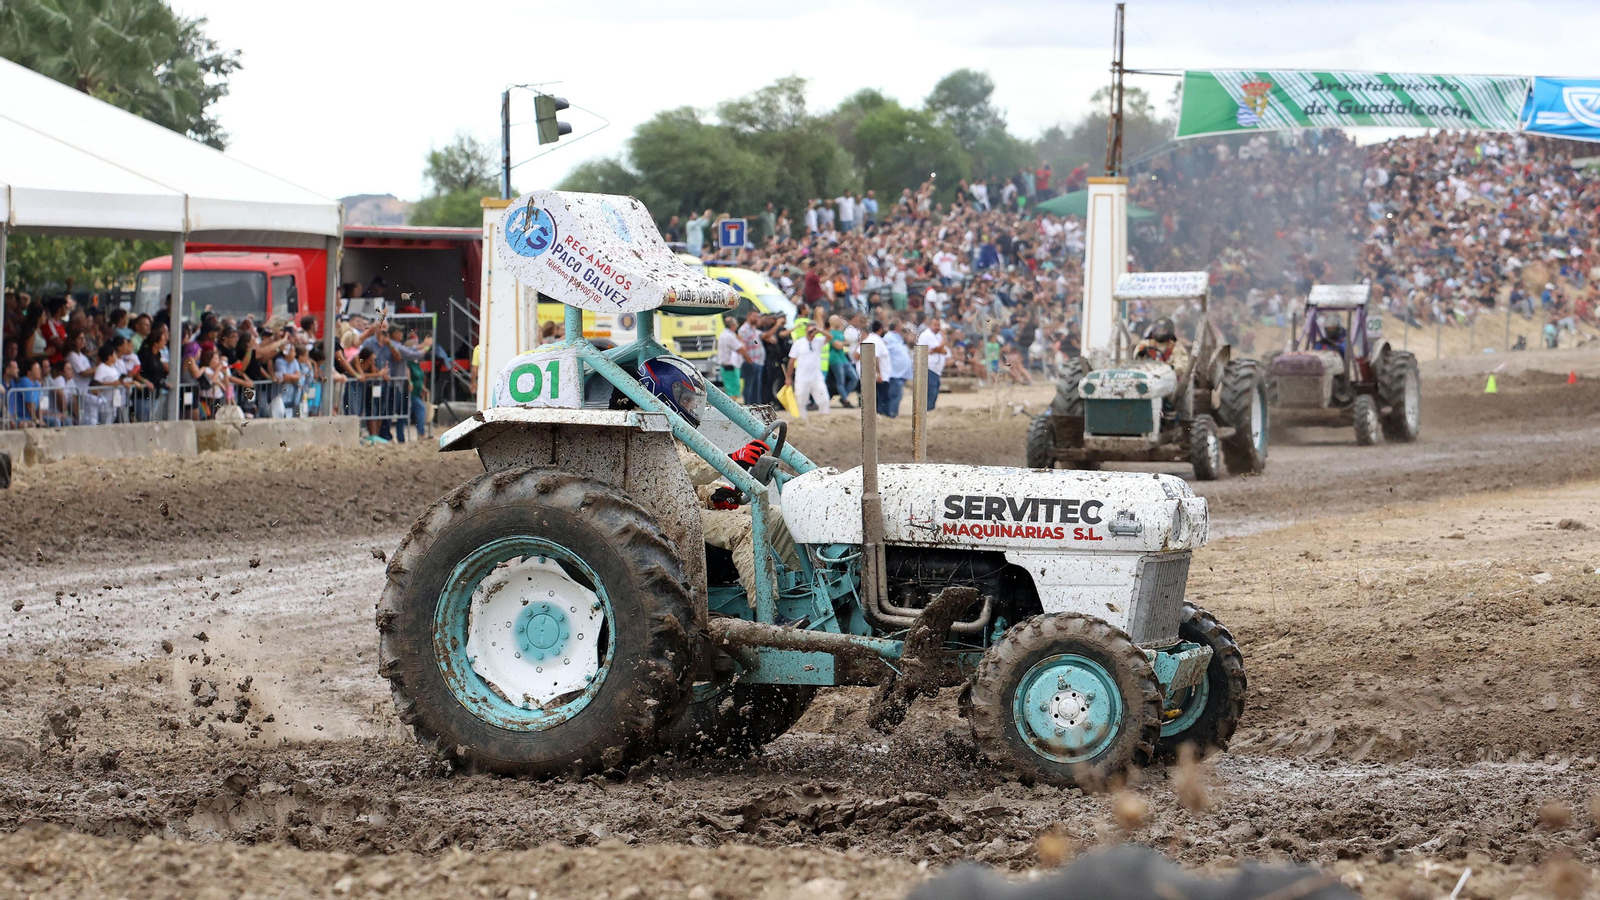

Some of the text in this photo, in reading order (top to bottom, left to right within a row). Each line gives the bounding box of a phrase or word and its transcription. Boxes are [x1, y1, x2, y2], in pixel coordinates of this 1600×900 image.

[1310, 79, 1460, 95] Ayuntamiento
[1304, 100, 1328, 116] de
[564, 235, 632, 291] RECAMBIOS
[551, 243, 583, 273] PACO
[583, 268, 628, 308] GALVEZ
[1366, 318, 1382, 331] 09
[509, 360, 560, 403] 01
[943, 494, 1104, 524] SERVITEC
[942, 522, 1103, 541] MAQUINARIAS S.L.
